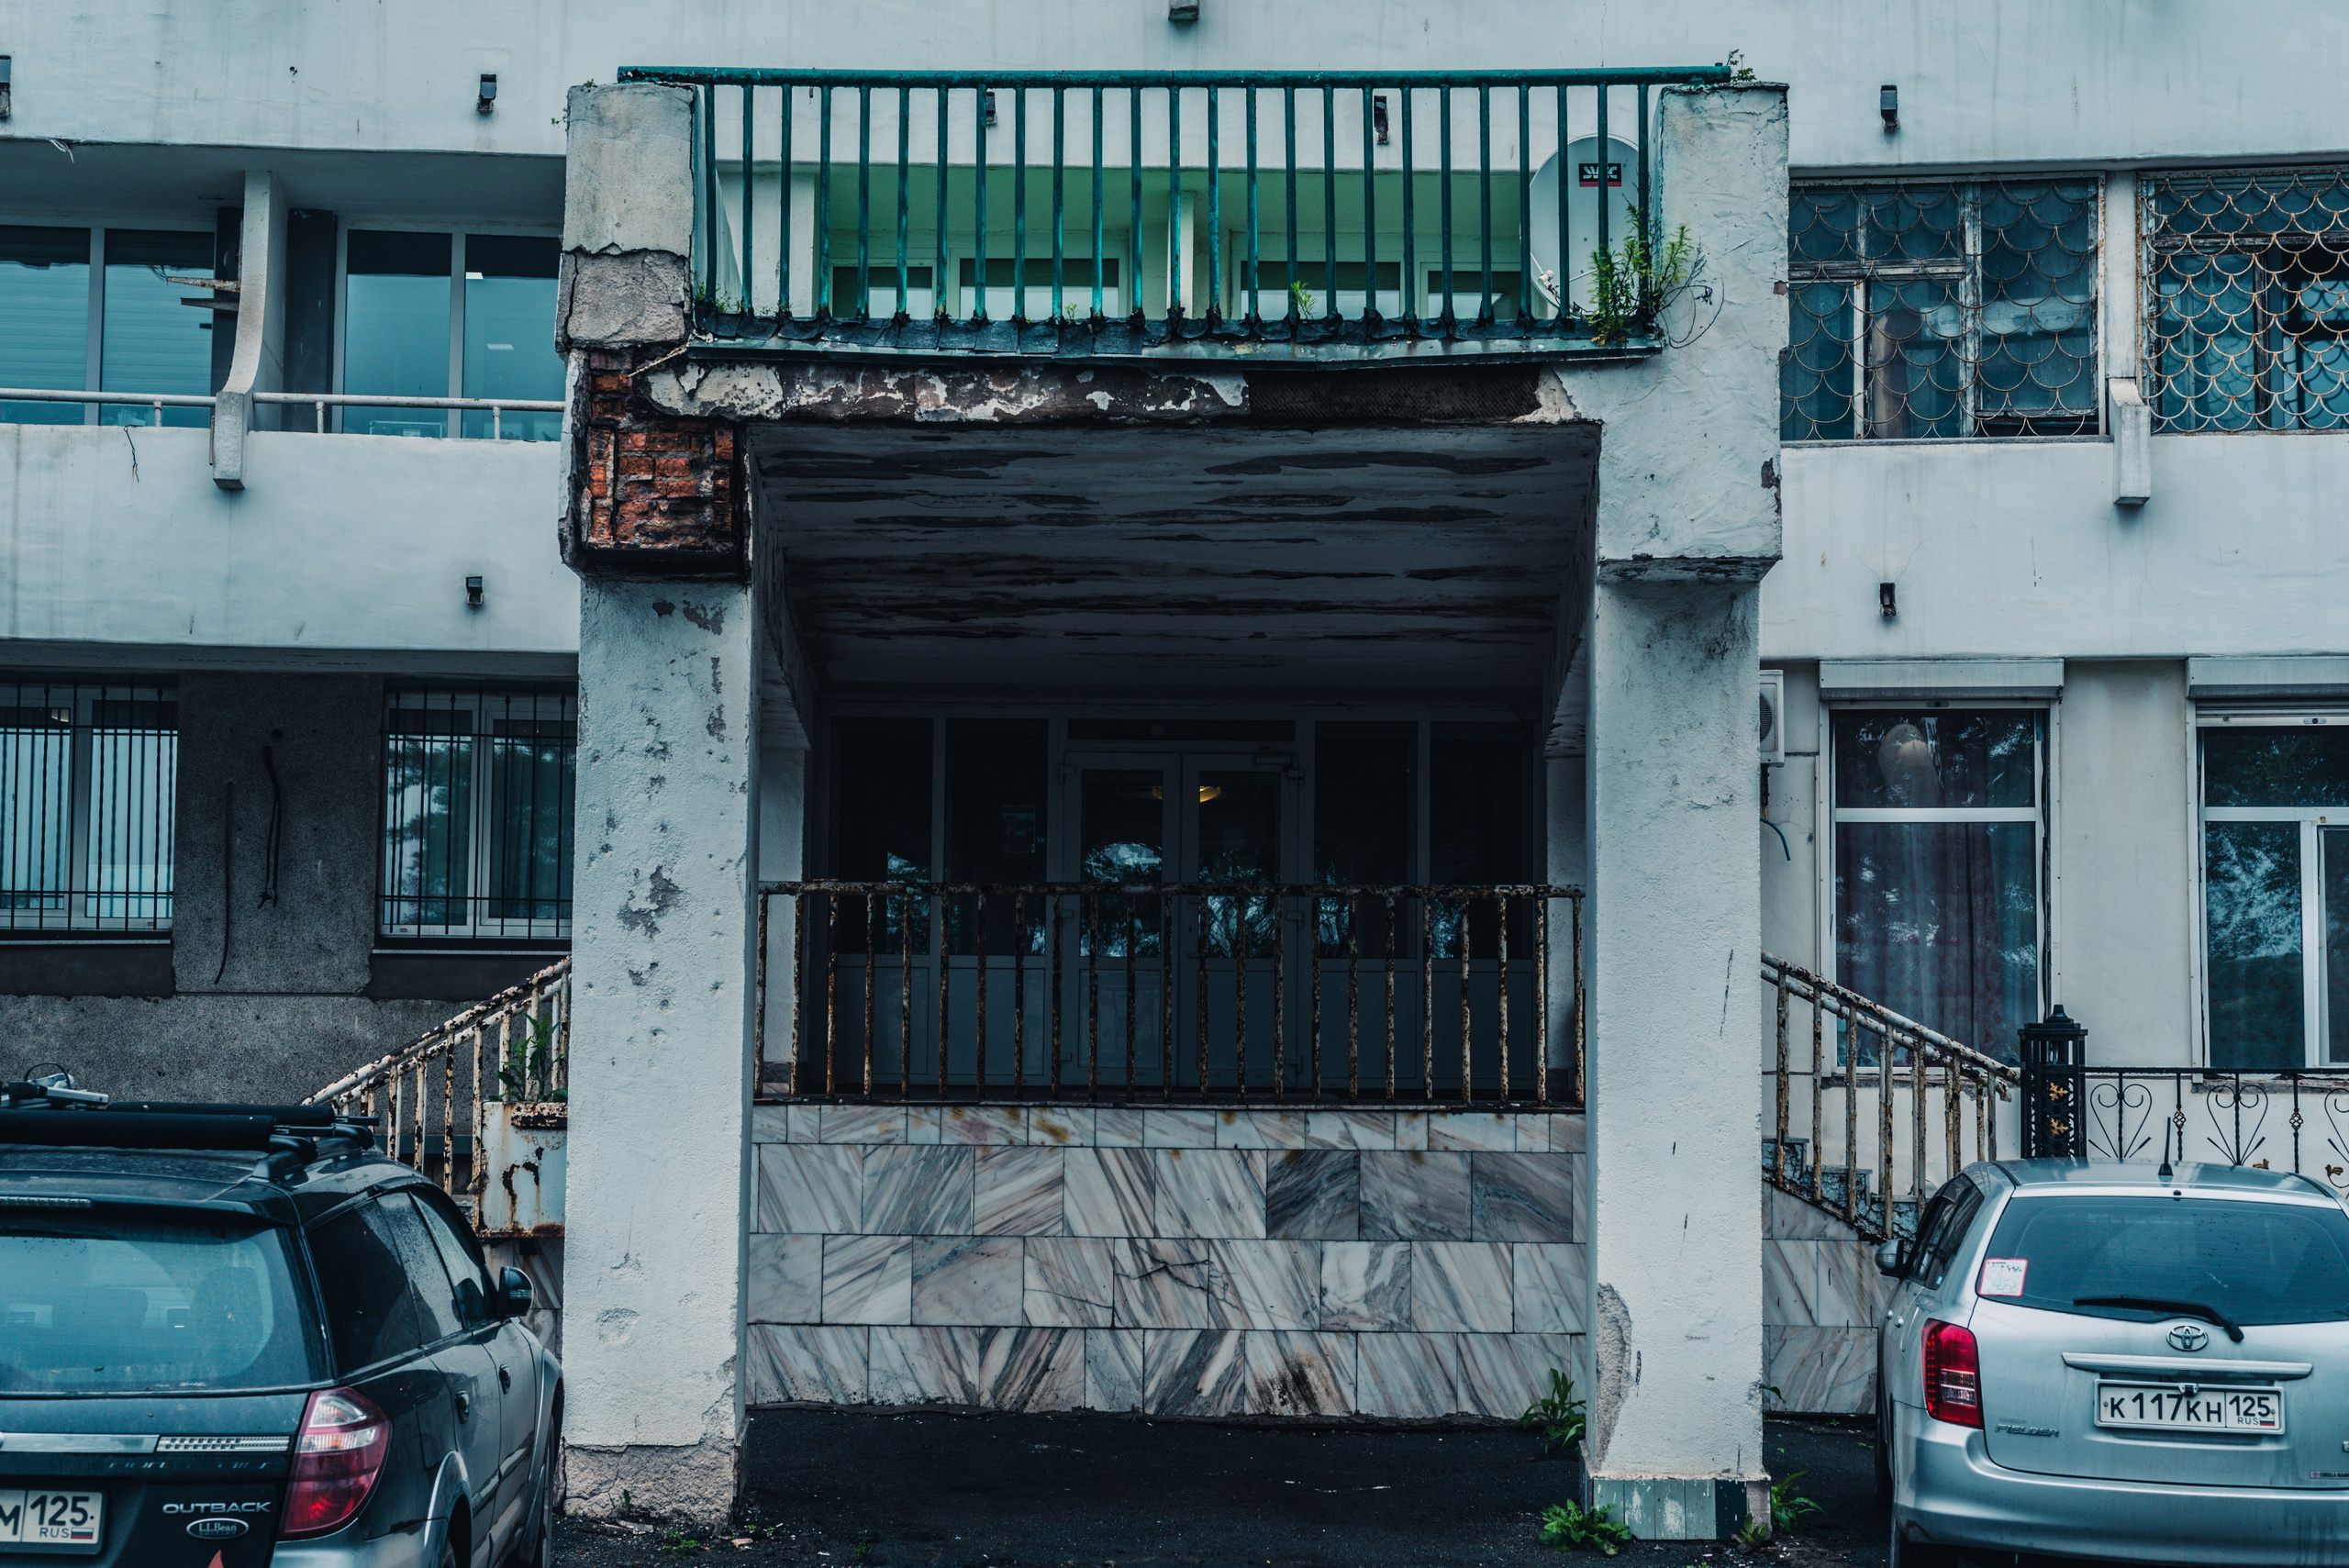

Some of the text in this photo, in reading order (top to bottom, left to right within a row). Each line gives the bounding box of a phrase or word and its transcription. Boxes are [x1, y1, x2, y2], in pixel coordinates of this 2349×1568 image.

[1583, 165, 1618, 180] SVC
[2229, 1395, 2271, 1417] 125
[2237, 1417, 2259, 1425] RUS
[1995, 1423, 2060, 1438] FIELDER
[29, 1495, 90, 1527] 125
[162, 1501, 272, 1514] OUTBACK
[39, 1527, 70, 1539] RUS
